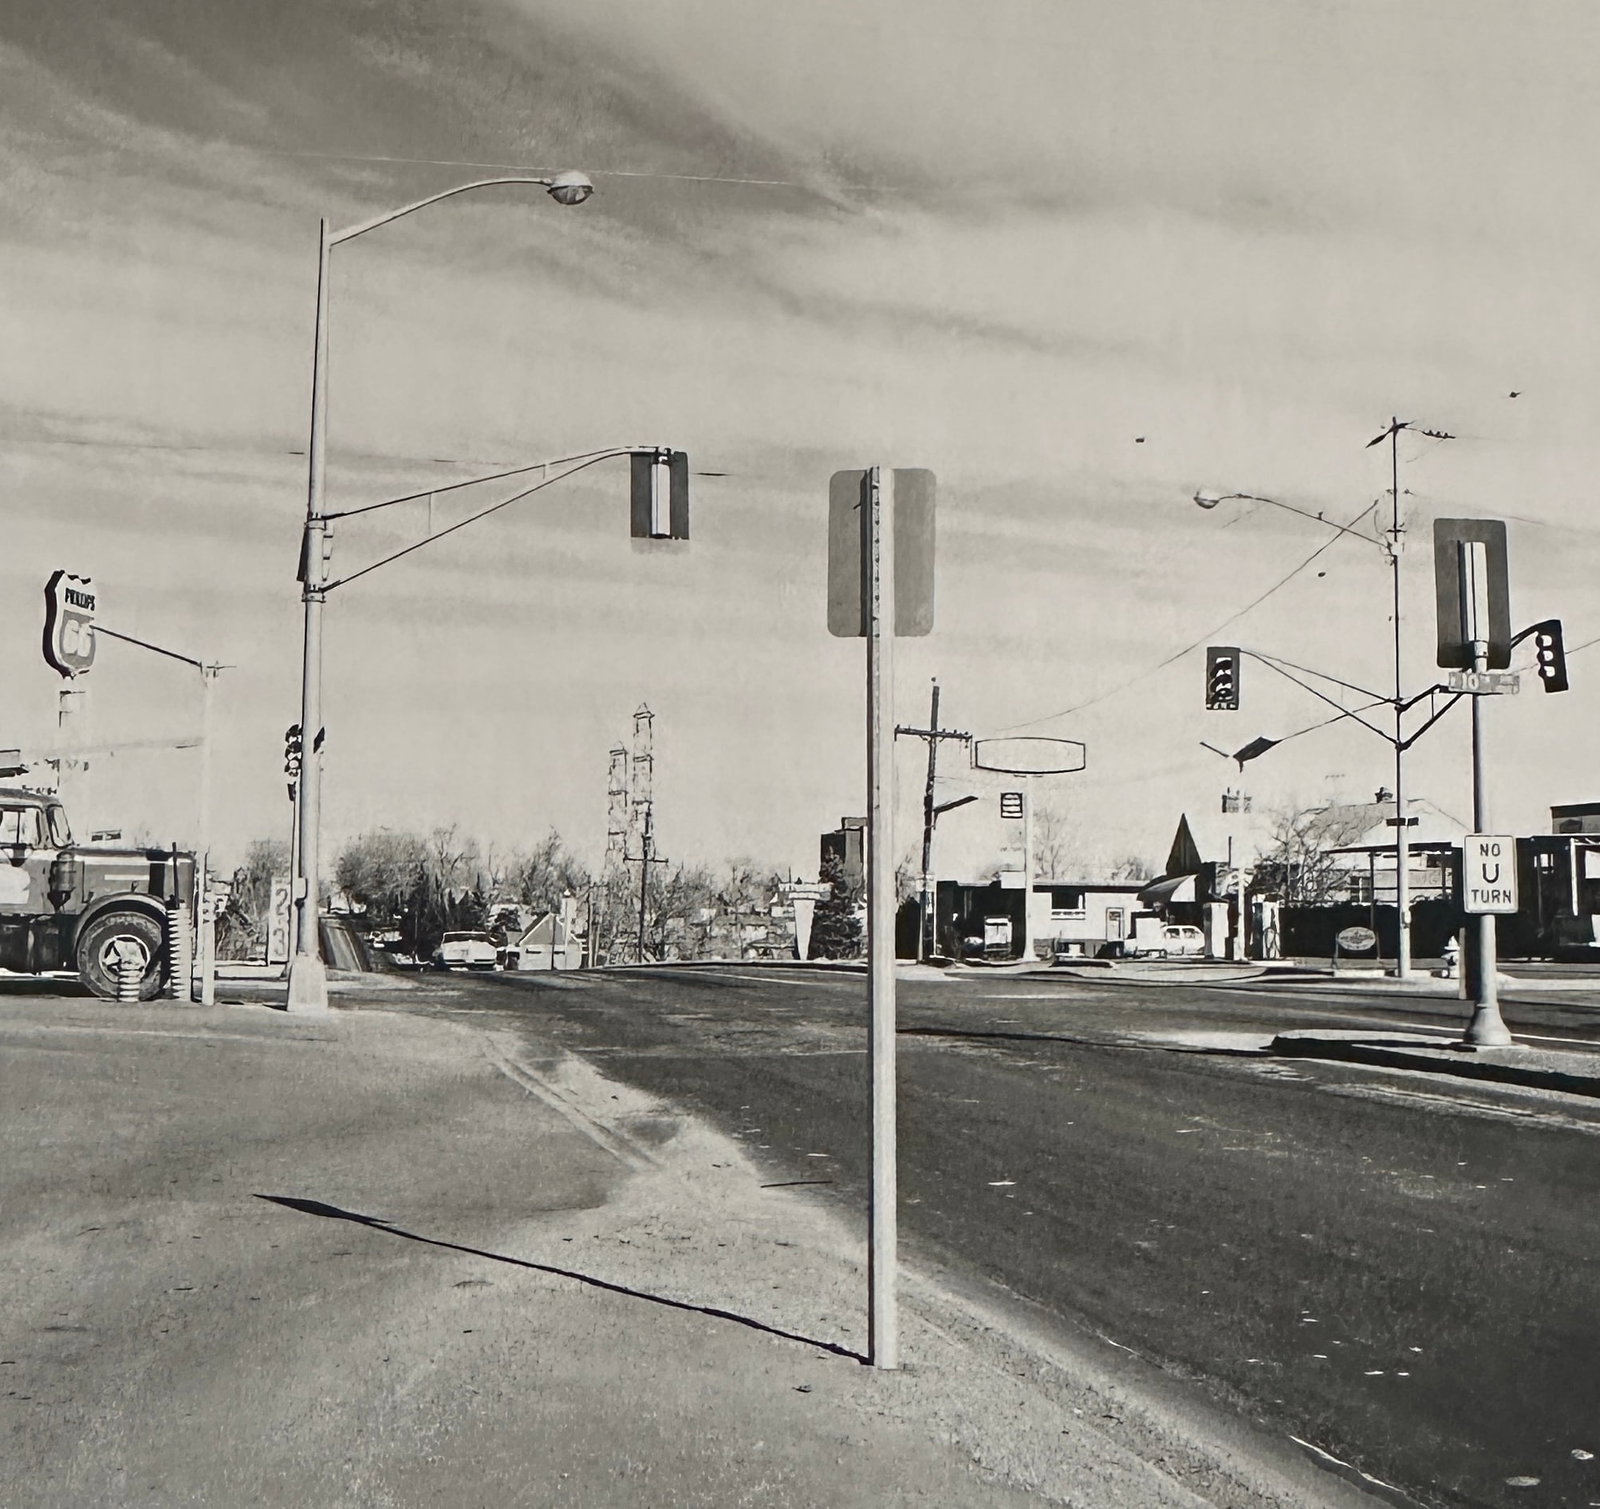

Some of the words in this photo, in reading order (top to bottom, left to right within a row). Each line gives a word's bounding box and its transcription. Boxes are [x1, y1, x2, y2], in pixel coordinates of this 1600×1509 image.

[1480, 843, 1501, 857] NO
[1482, 863, 1500, 884] U
[1471, 889, 1511, 904] TURN
